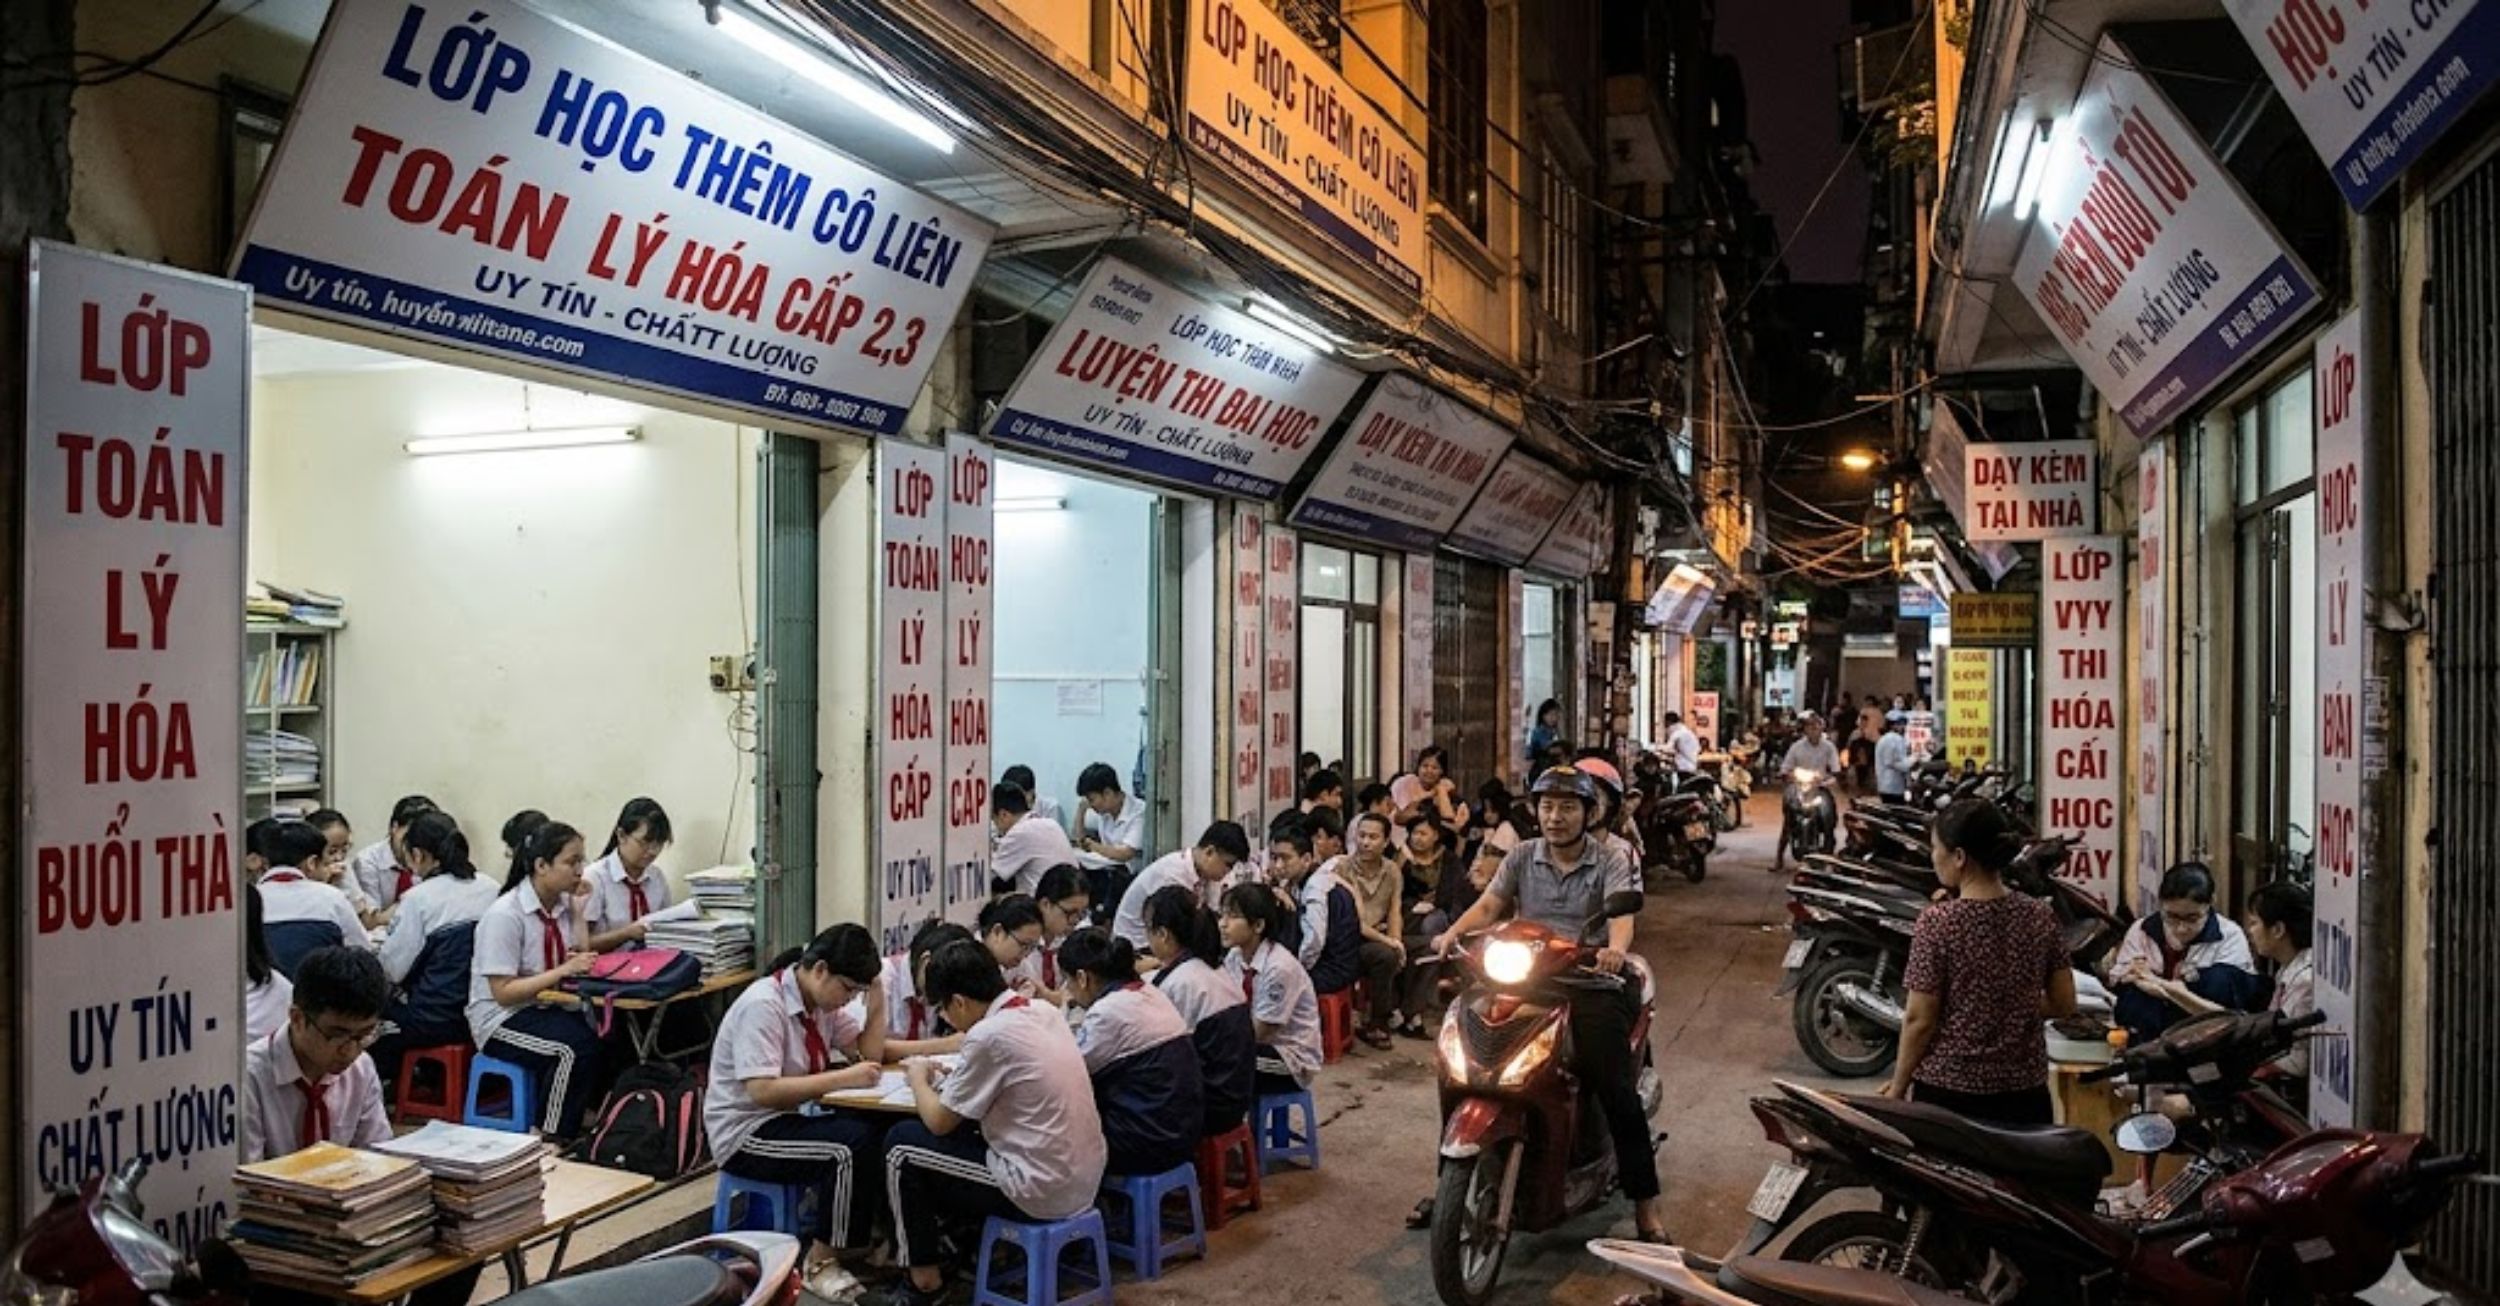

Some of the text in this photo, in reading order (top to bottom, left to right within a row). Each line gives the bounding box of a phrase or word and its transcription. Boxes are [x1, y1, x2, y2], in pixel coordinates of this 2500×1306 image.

[2346, 65, 2374, 110] UY
[2367, 28, 2408, 81] TÍN
[382, 4, 962, 290] LỚP HỌC THÊM CÔ LIÊN
[1227, 91, 1252, 137] UY
[1259, 116, 1290, 165] TÍN
[1305, 154, 1348, 208] CHẤT
[1254, 33, 1297, 111] HỌC
[1303, 73, 1354, 161] THÊM
[1359, 126, 1380, 180] CÔ
[1386, 147, 1419, 213] LIÊN
[2107, 82, 2197, 215] TỐI
[283, 265, 322, 299] Uy
[341, 125, 927, 367] TOÁN LÝ HÓA CẤP 2,3
[79, 293, 212, 397] LỚP
[473, 264, 536, 297] UY
[539, 275, 599, 321] TÍN
[622, 301, 724, 356] CHẤTT
[726, 331, 819, 378] LƯỢNG
[1055, 328, 1178, 404] LUYỆN
[1169, 367, 1227, 419] THI
[1261, 404, 1319, 453] HỌC
[1084, 403, 1111, 426] UY
[1113, 410, 1147, 436] TÍN
[2323, 345, 2355, 430] LỚP
[57, 427, 224, 527] TOÁN
[894, 461, 933, 518] LỚP
[952, 449, 988, 506] LỚP
[1974, 449, 2087, 491] DẠY KÈM
[2323, 463, 2357, 546] HỌC
[1976, 493, 2084, 536] TẠI NHÀ
[106, 554, 180, 650] LÝ
[886, 535, 939, 591] TOÁN
[951, 535, 988, 594] HỌC
[2053, 544, 2112, 581] LỚP
[901, 609, 924, 666] LÝ
[959, 610, 980, 666] LÝ
[2329, 565, 2349, 645] LÝ
[2058, 649, 2107, 679] THI
[84, 683, 197, 784] HÓA
[891, 683, 933, 741] HÓA
[950, 688, 987, 746] HÓA
[2051, 691, 2115, 728] HÓA
[890, 755, 931, 822] CẤP
[950, 760, 986, 828] CẤP
[38, 803, 234, 934] BUỔI THÀ
[69, 1004, 120, 1076] UY
[131, 976, 193, 1063] TÍN
[38, 1084, 235, 1185] CHẤT LƯỢNG
